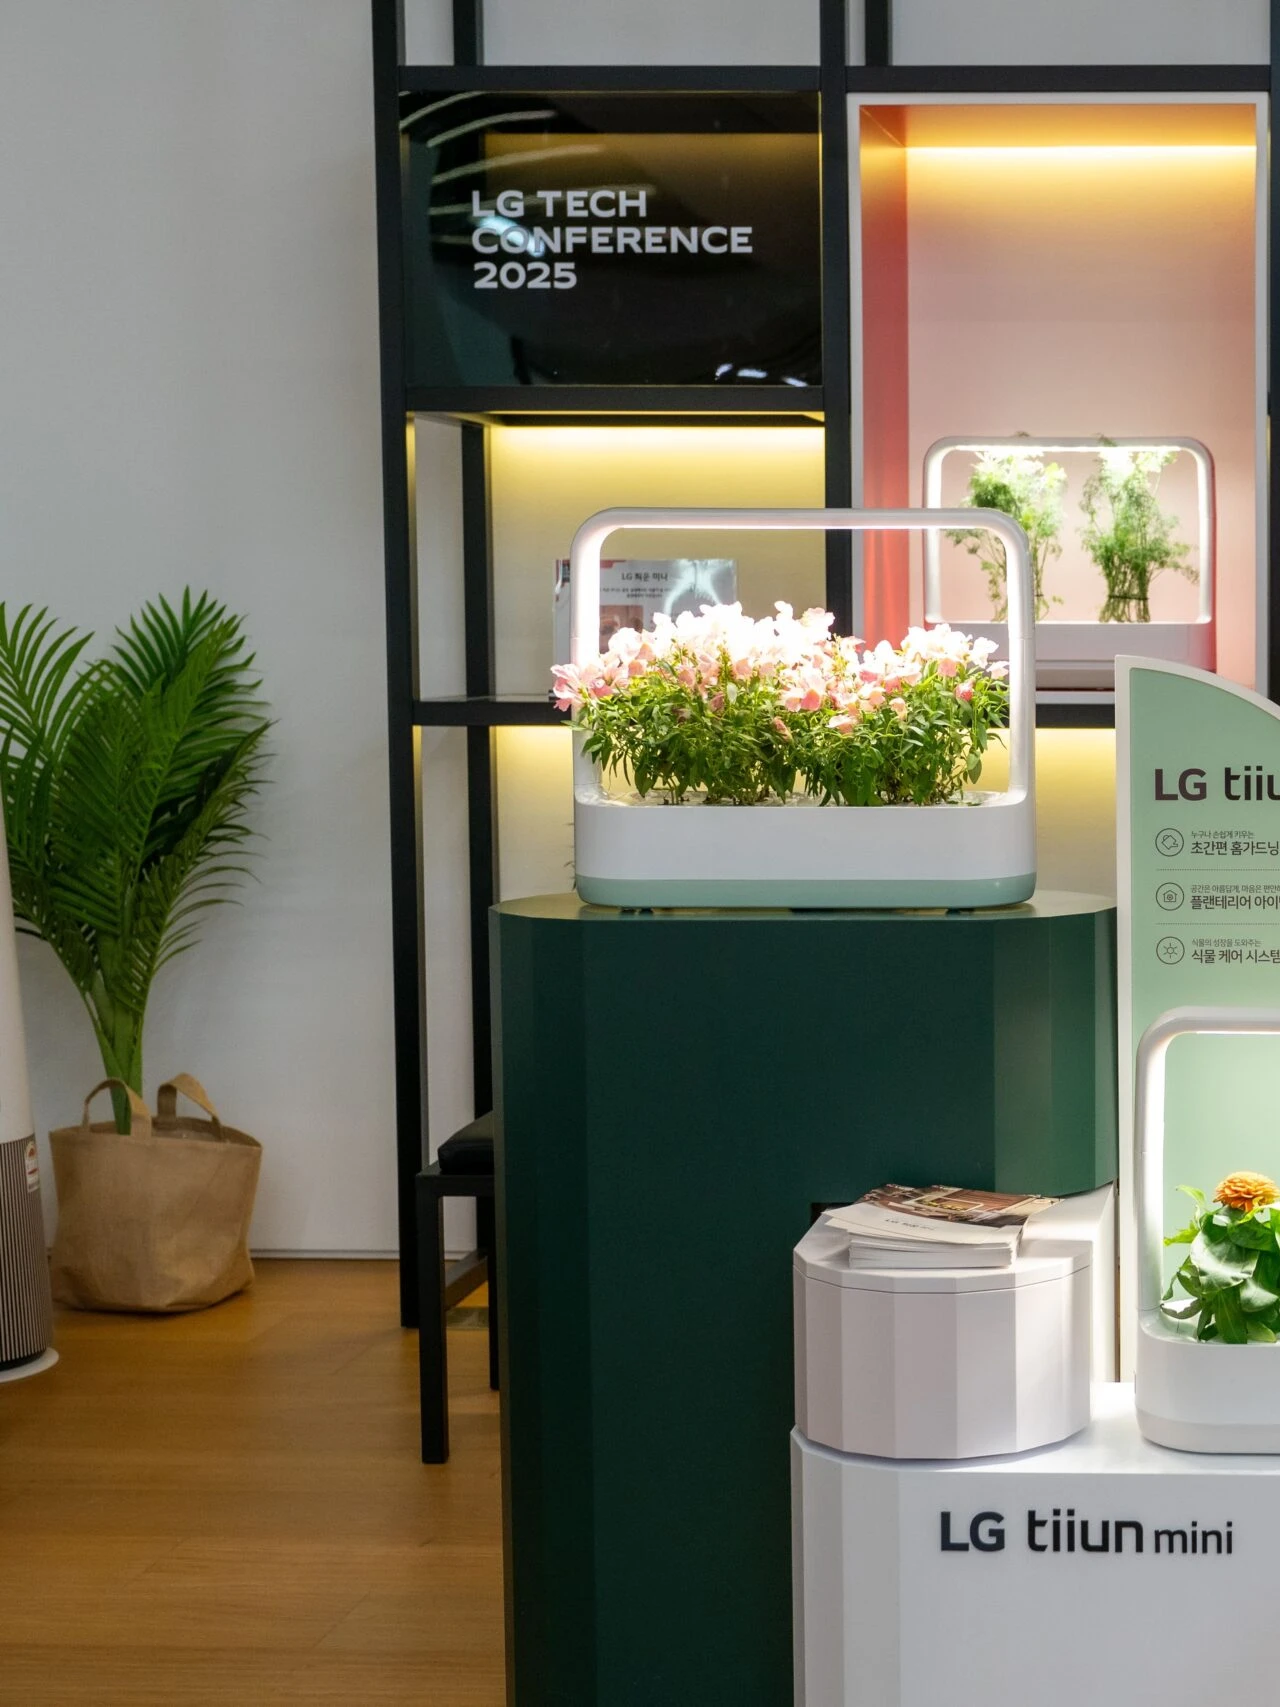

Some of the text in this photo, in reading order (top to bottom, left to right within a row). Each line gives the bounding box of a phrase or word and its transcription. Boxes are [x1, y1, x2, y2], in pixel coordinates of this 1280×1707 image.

[472, 190, 647, 217] LG TECH
[471, 226, 753, 254] CONFERENCE
[473, 261, 578, 289] 2025
[621, 572, 633, 581] LG
[1155, 768, 1207, 801] LG
[1190, 830, 1211, 839] 누구나
[1234, 830, 1256, 839] 키우는
[1190, 841, 1280, 856] 초간편 홈가드닝
[1190, 884, 1211, 894] 공간은
[1241, 884, 1262, 894] 마음은
[1190, 895, 1251, 910] 플랜테리어
[1191, 938, 1263, 948] 식물의 성장을 도와주는
[1191, 949, 1216, 964] 식물
[1218, 949, 1243, 964] 케어
[940, 1508, 1233, 1554] LG tiiun mini
